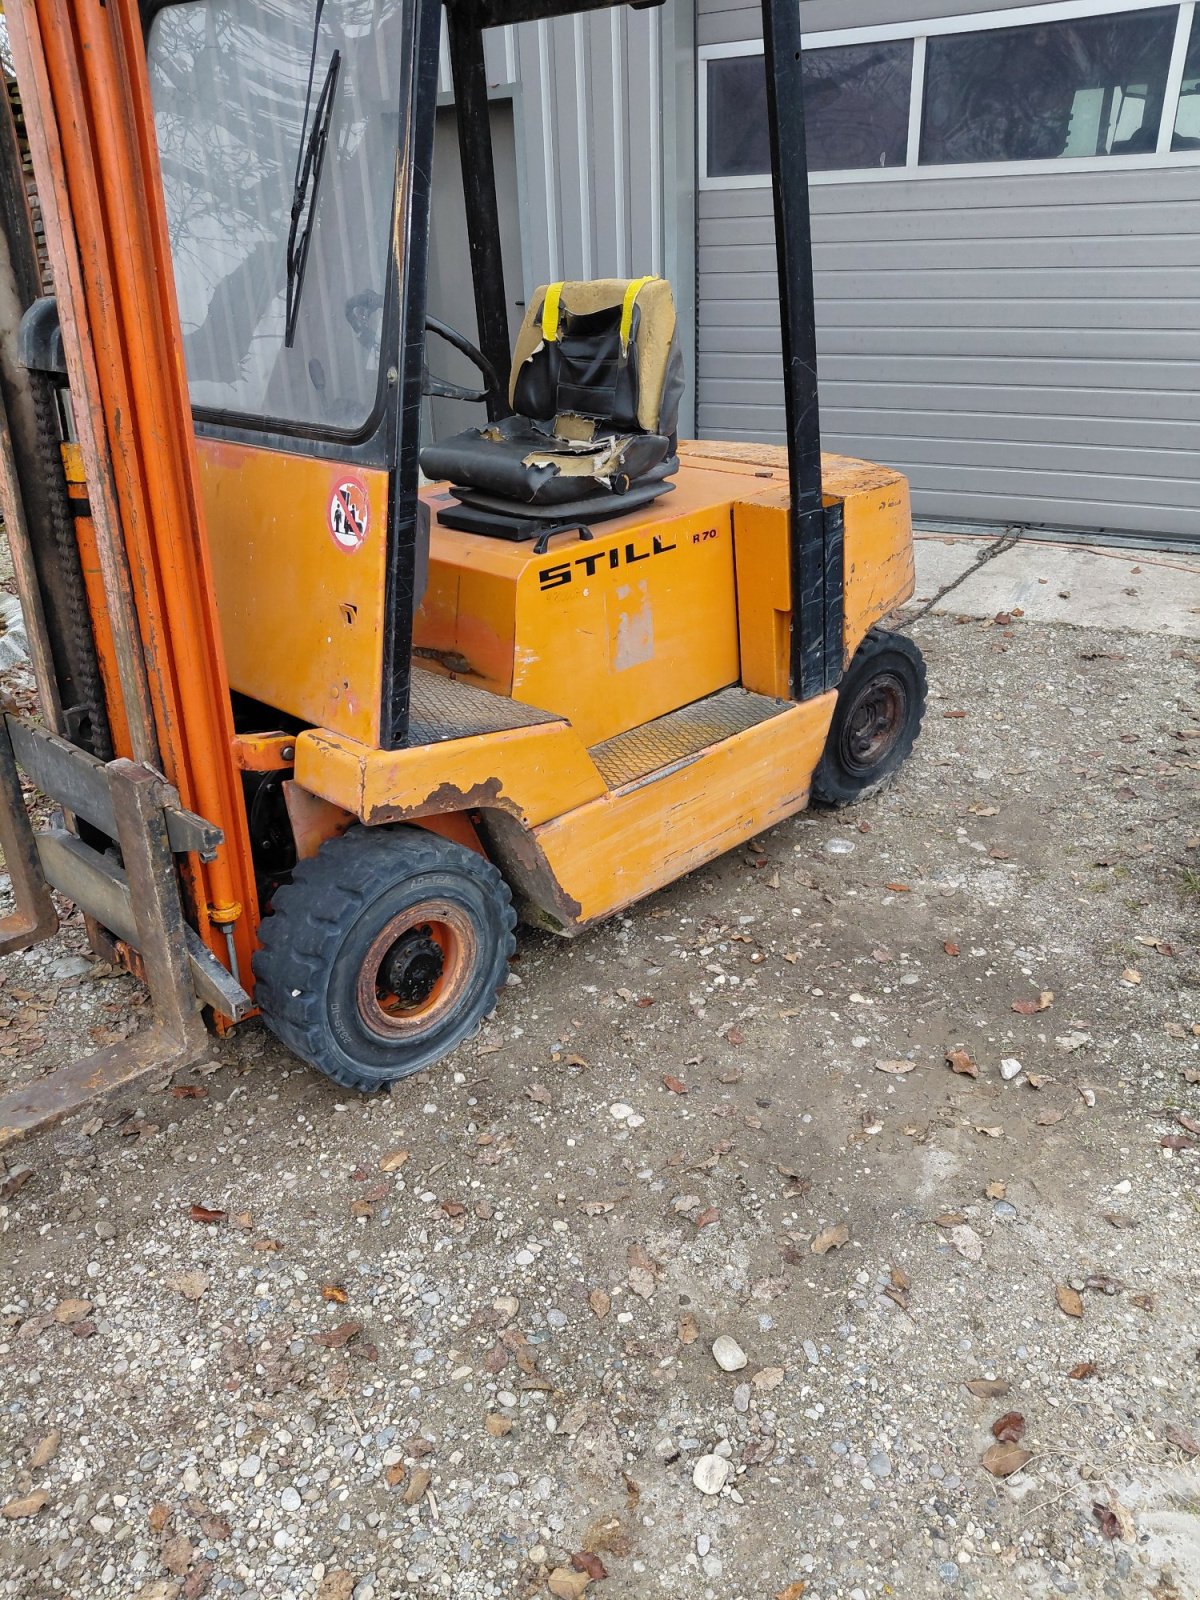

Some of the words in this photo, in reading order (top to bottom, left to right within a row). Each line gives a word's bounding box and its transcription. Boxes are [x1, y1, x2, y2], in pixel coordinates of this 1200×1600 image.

[692, 532, 700, 545] R
[703, 529, 717, 541] 70
[539, 535, 677, 591] STILL
